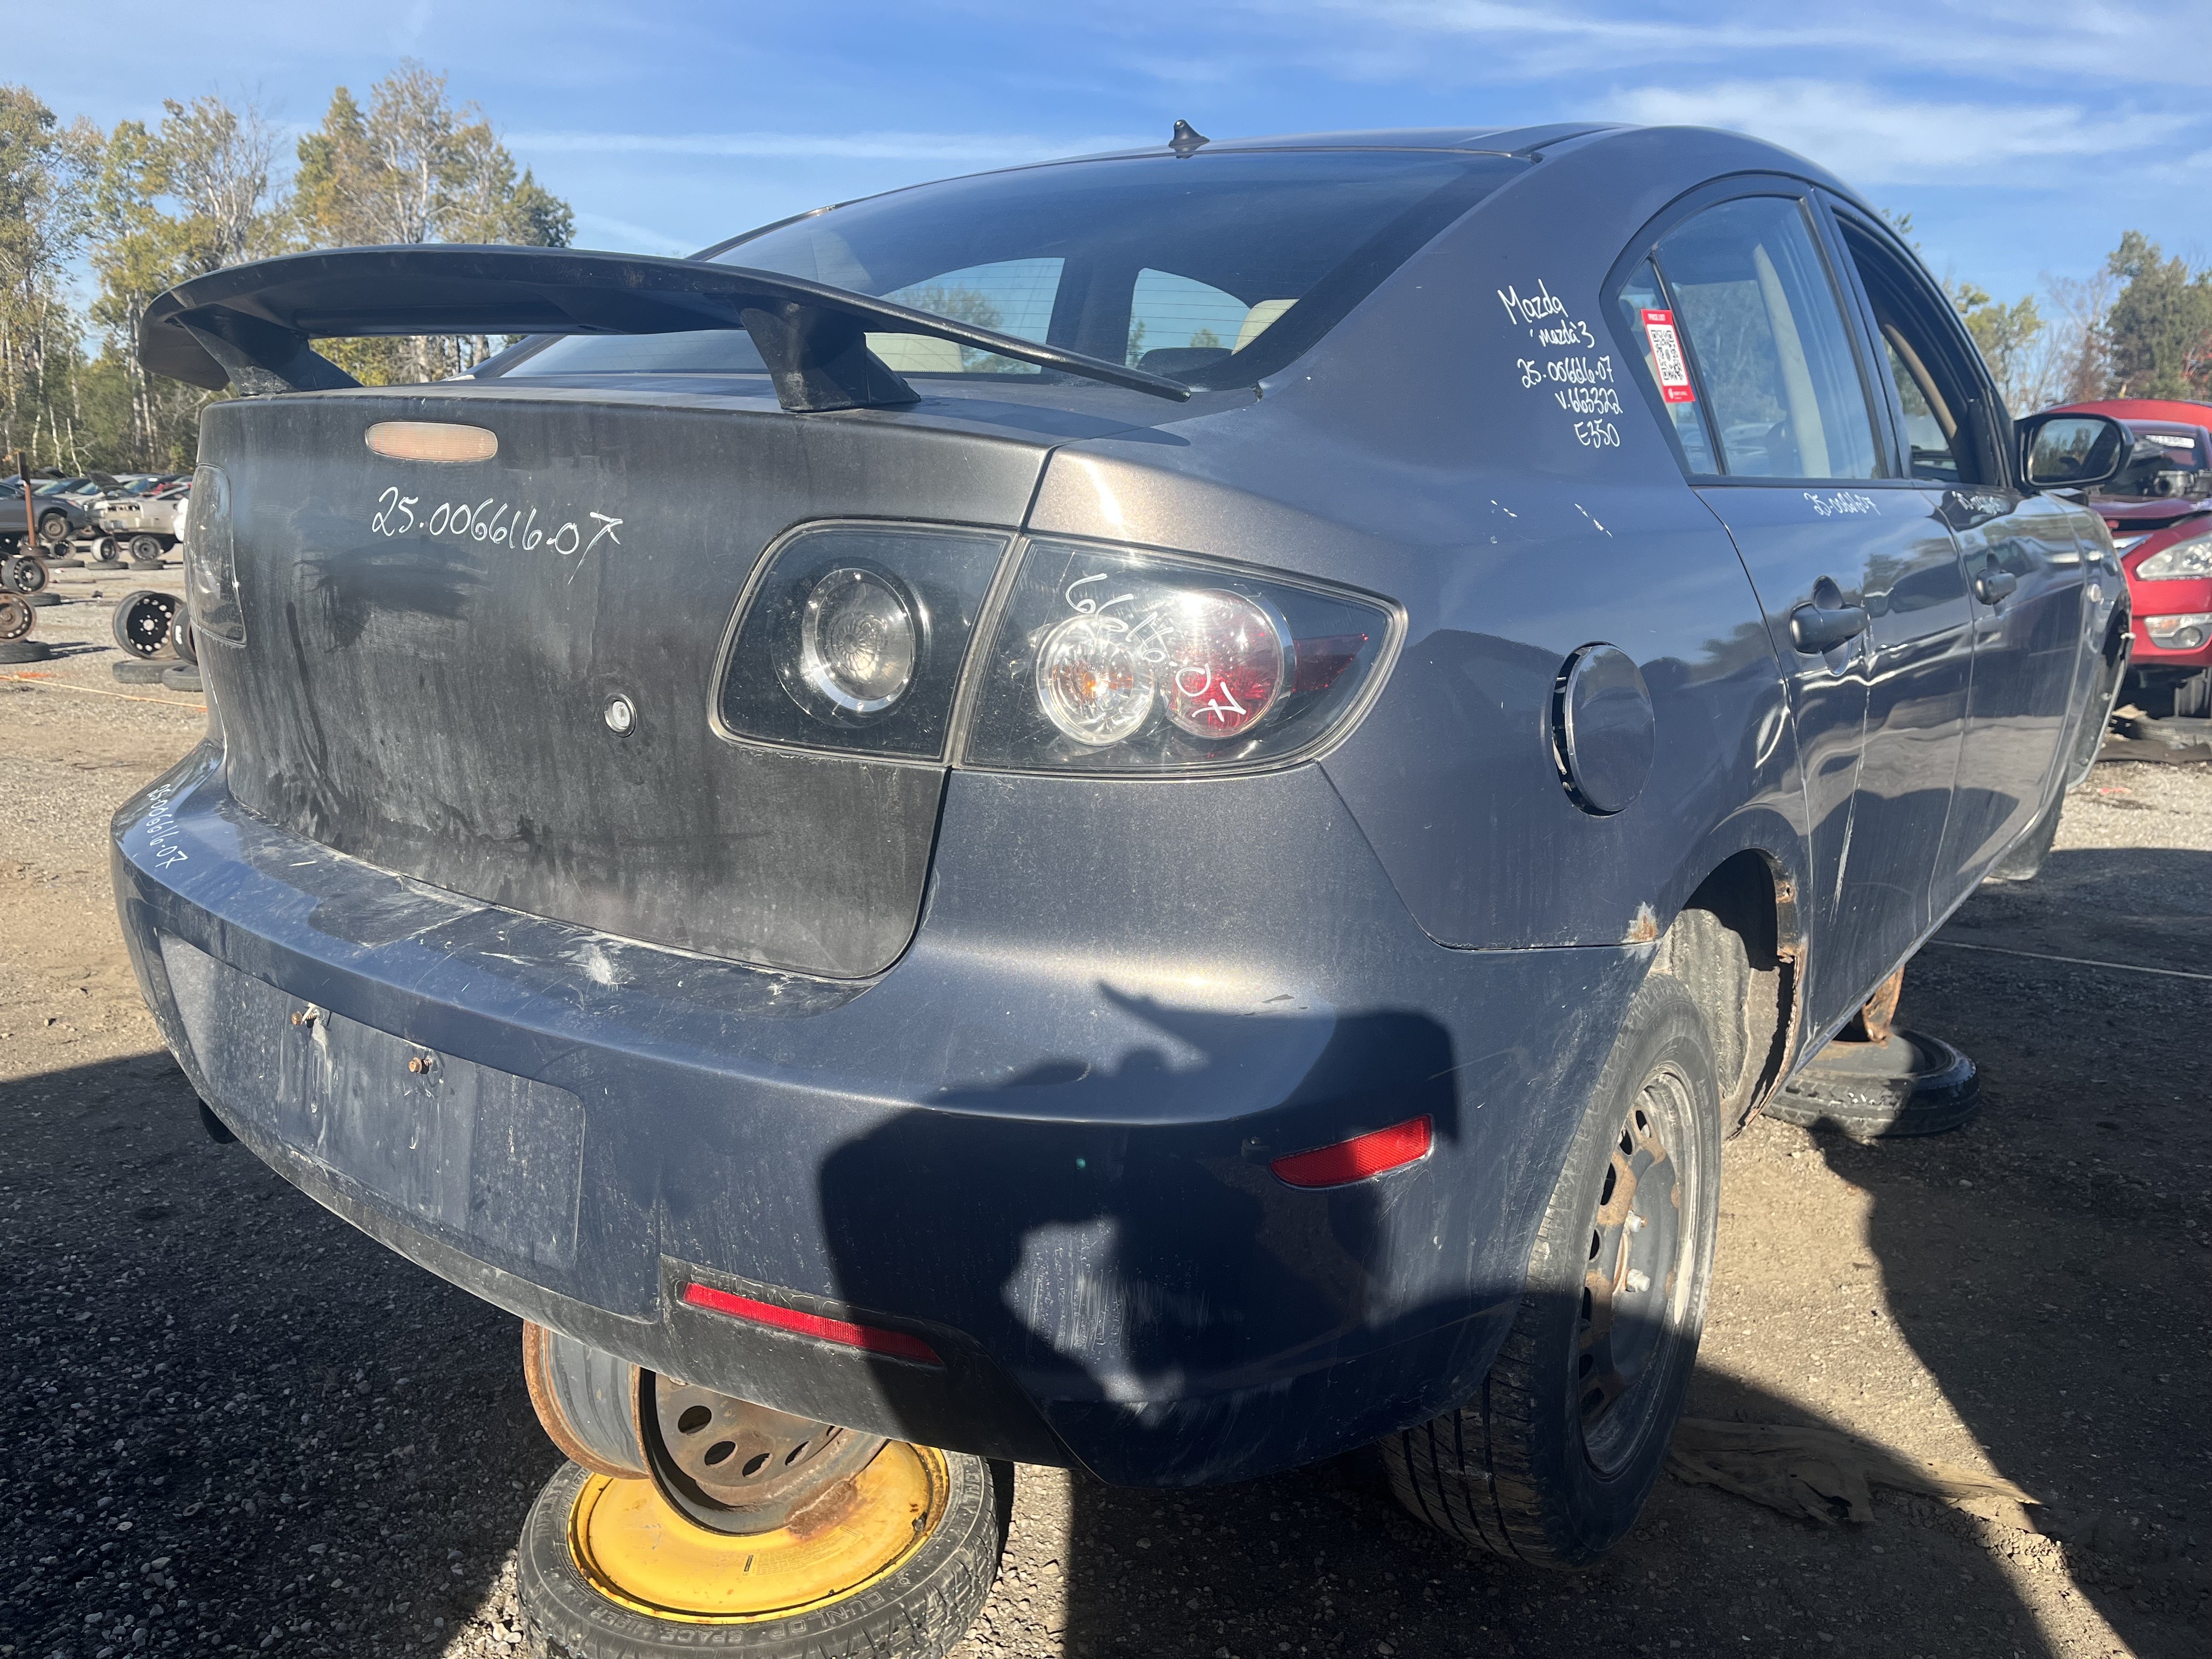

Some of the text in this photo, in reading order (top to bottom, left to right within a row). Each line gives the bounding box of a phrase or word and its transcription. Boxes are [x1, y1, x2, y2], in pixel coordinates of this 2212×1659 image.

[1497, 279, 1568, 324] Mazda
[1574, 419, 1620, 448] E350
[372, 487, 623, 585] 25.006616.07
[659, 1627, 743, 1645] SPACE
[770, 1591, 885, 1640] DUNLOP
